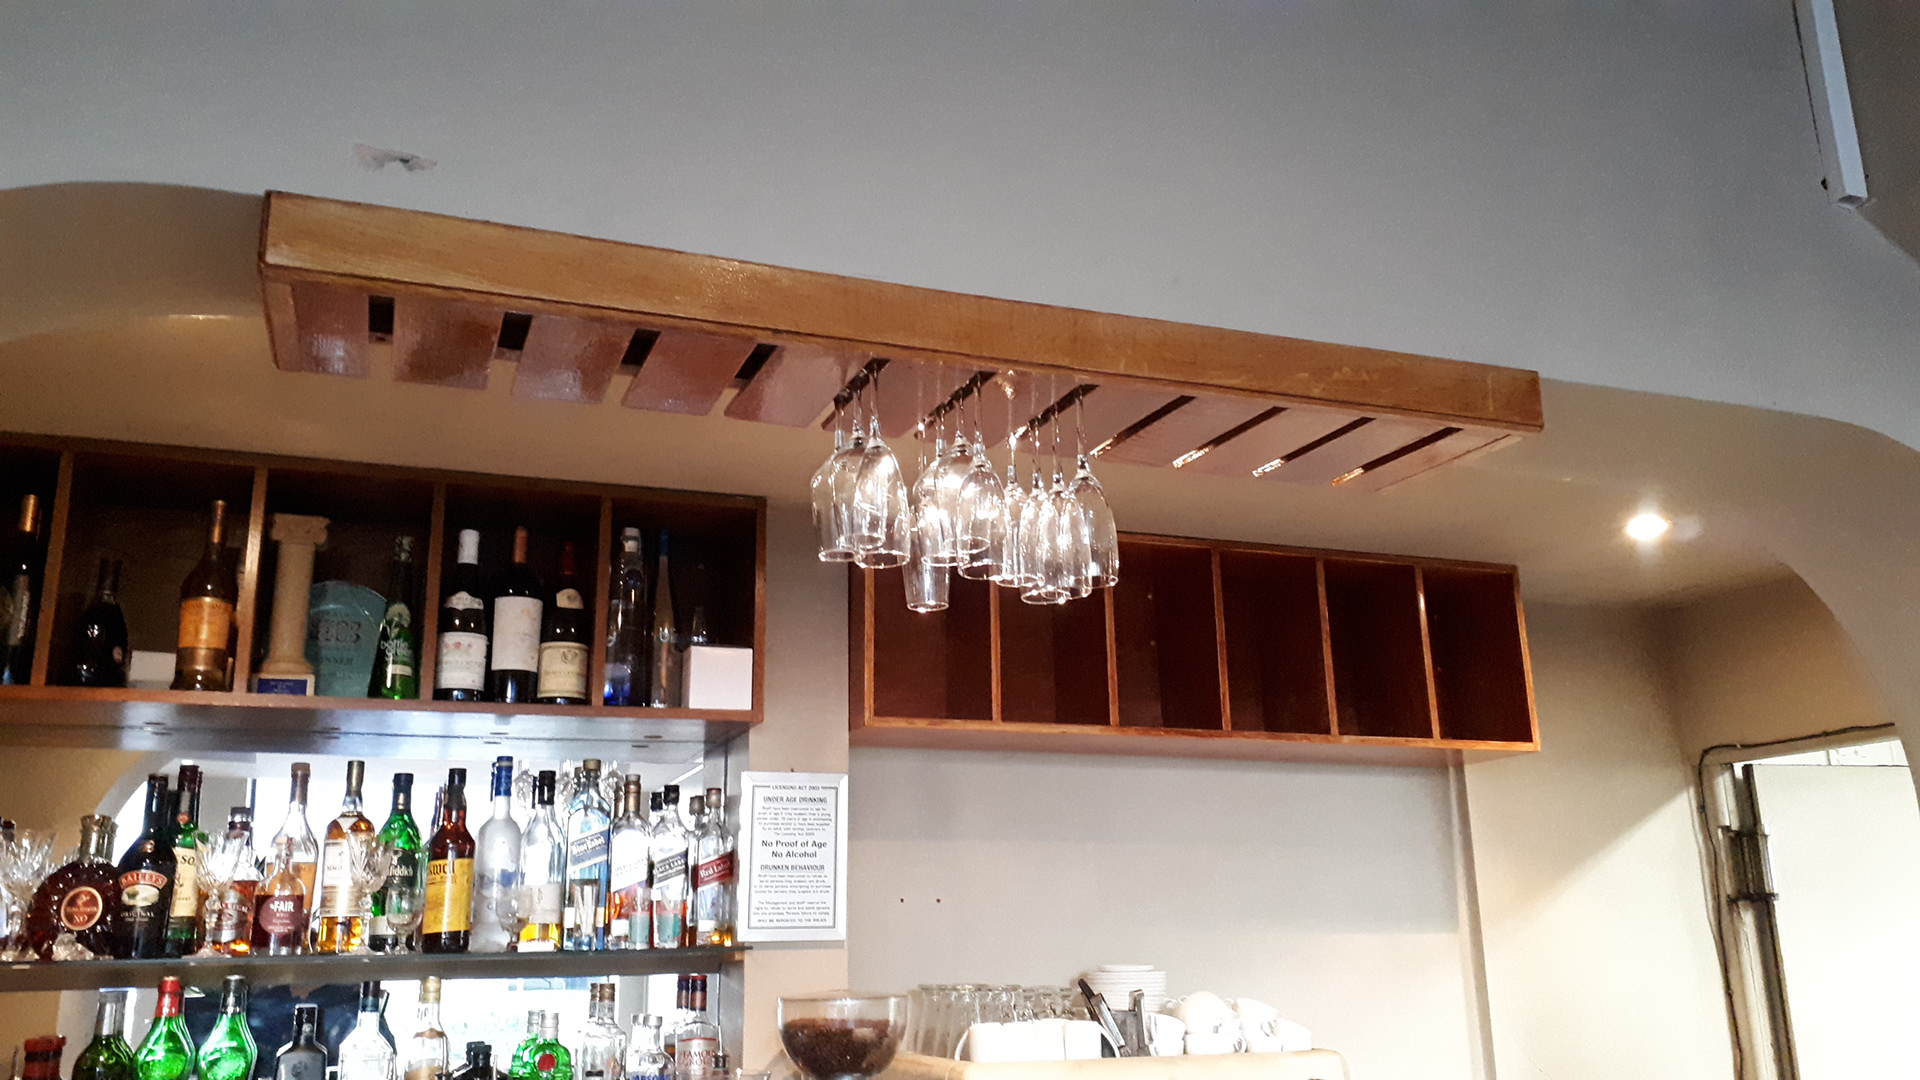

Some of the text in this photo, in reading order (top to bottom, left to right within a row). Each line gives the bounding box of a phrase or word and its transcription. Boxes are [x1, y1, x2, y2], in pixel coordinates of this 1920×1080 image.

[571, 843, 588, 856] Blue
[761, 840, 828, 849] No Proof of Age
[785, 850, 817, 858] Alcohol
[121, 871, 163, 885] BAILEYS
[700, 866, 714, 878] Red
[273, 900, 295, 913] FAIR
